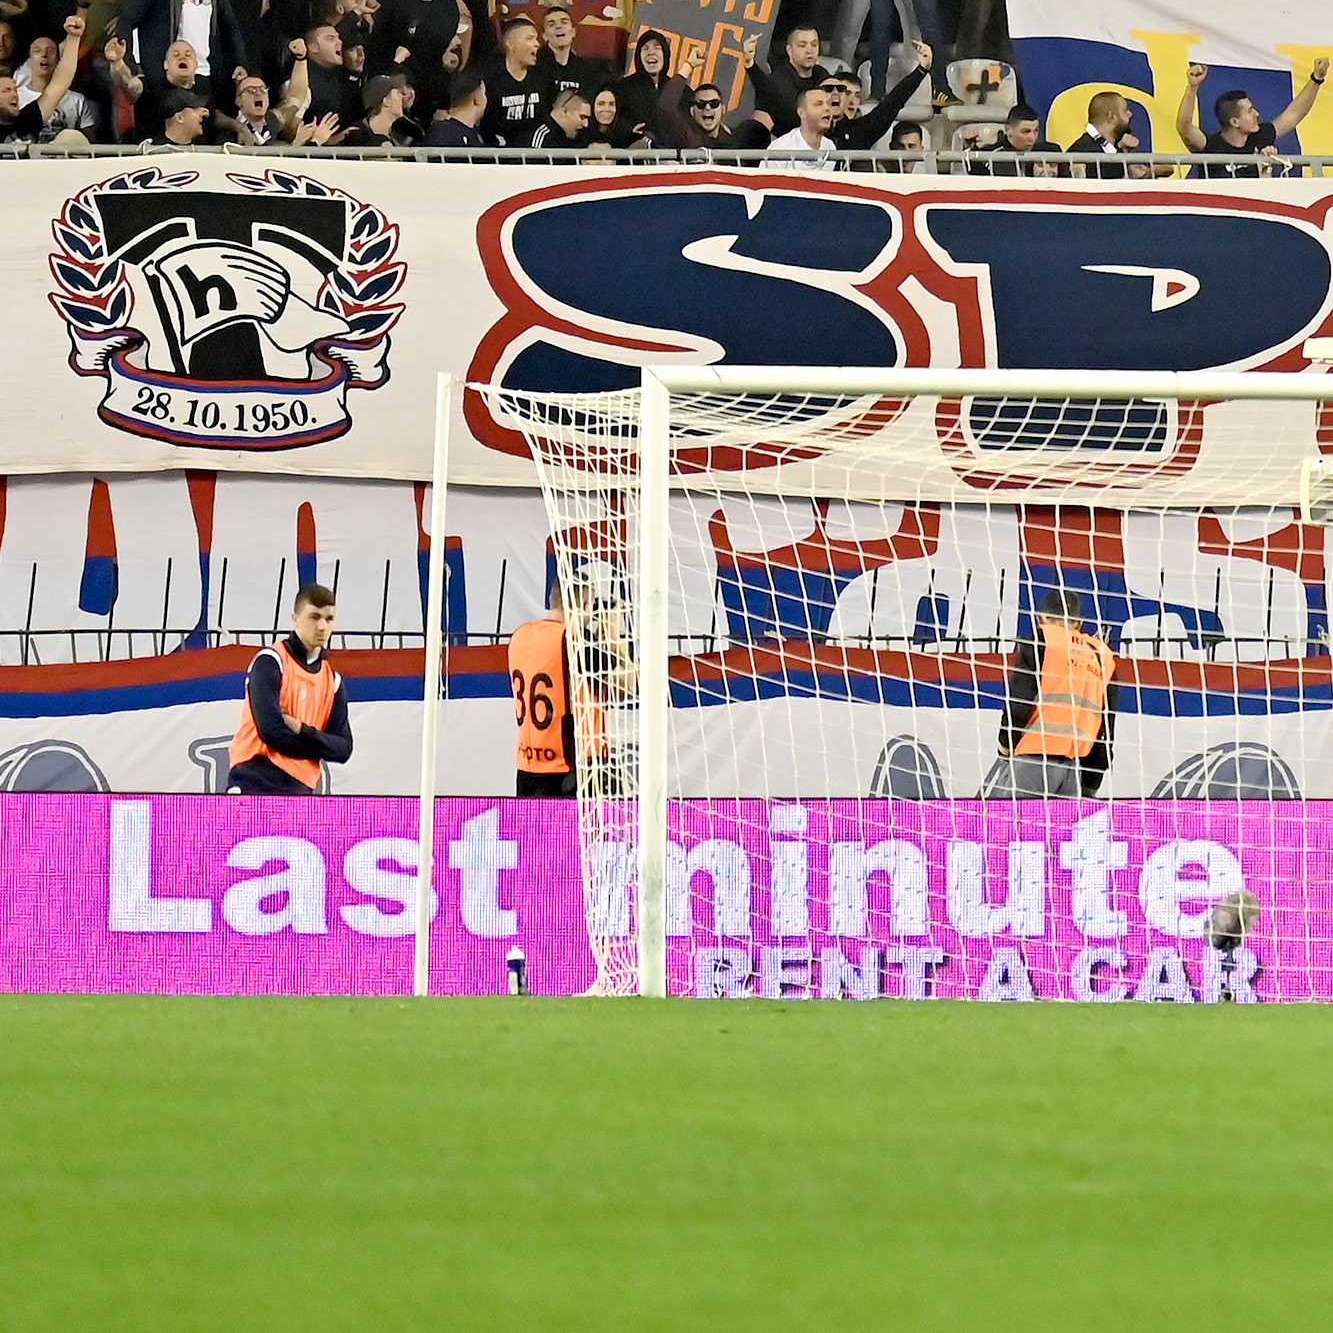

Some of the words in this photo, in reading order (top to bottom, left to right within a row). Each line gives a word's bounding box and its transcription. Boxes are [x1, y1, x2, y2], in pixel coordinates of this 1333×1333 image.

[512, 669, 555, 731] 36
[108, 799, 517, 938] Last
[606, 804, 1247, 941] minute
[696, 946, 944, 1002] RENT
[977, 947, 1035, 1004] A
[1070, 947, 1263, 1004] CAR
